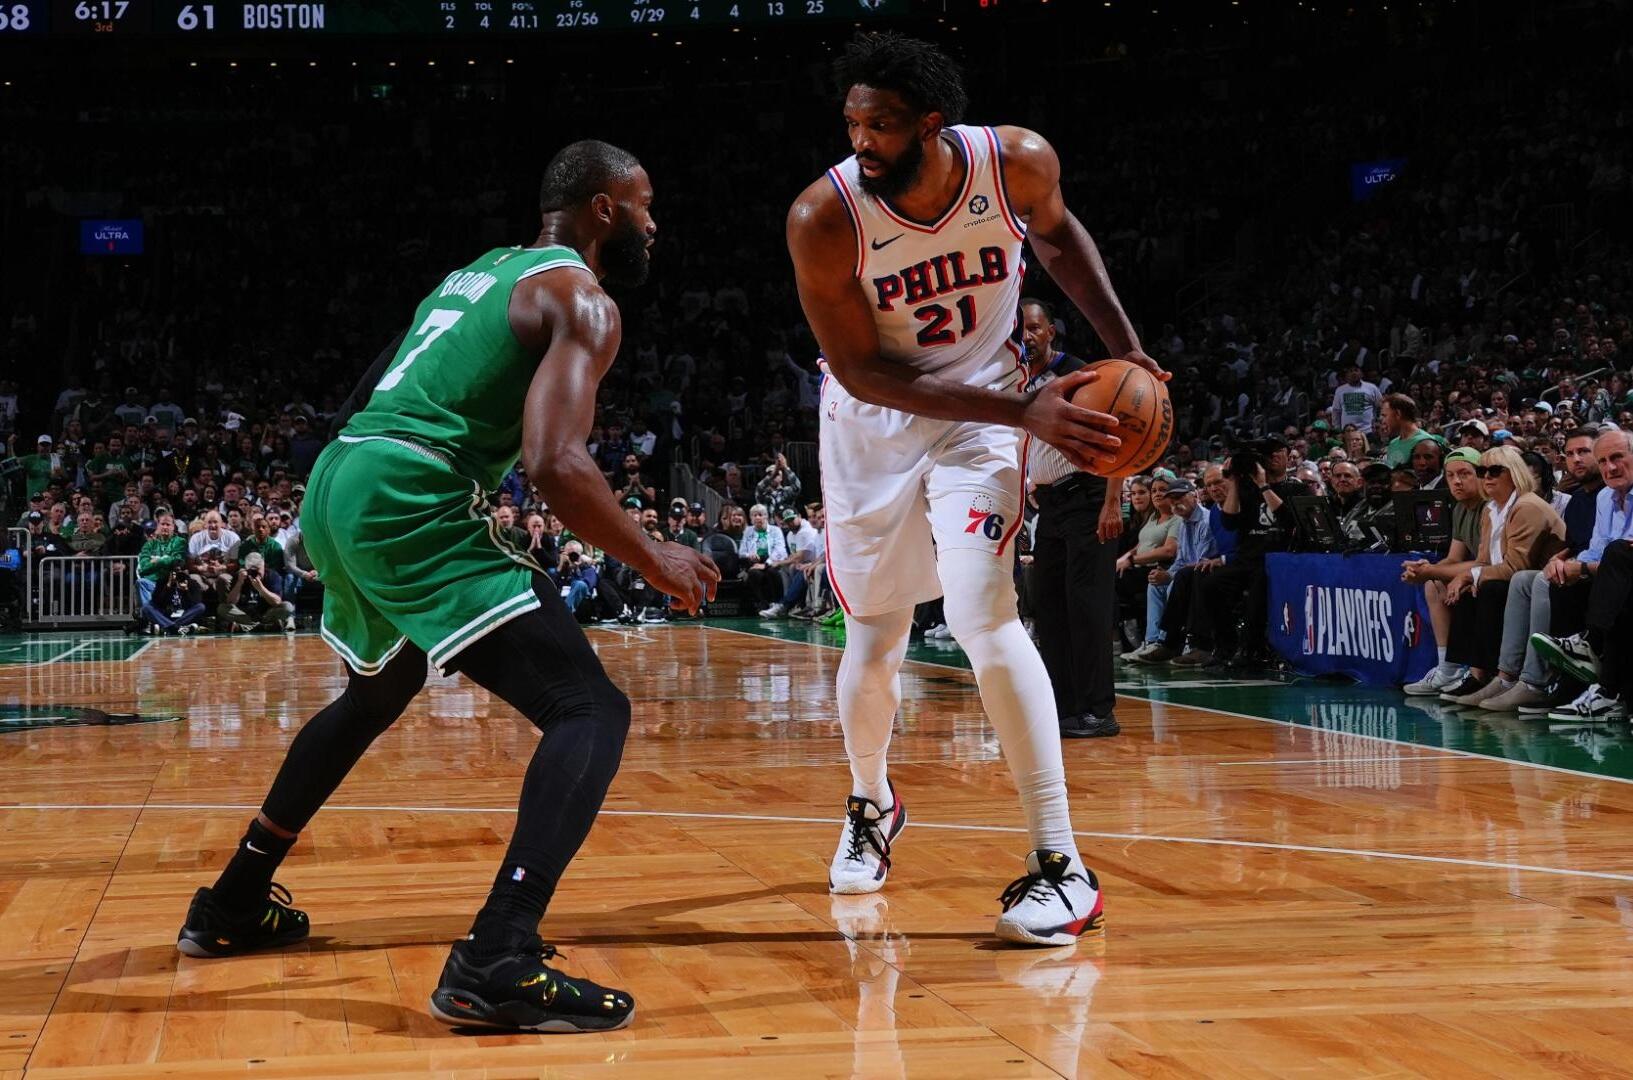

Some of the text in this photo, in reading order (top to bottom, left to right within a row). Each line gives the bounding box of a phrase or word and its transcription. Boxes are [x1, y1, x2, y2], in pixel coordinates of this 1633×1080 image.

[74, 1, 130, 20] 6:17
[176, 5, 215, 30] 61
[243, 4, 325, 30] BOSTON
[440, 3, 457, 11] FLS
[474, 3, 493, 11] TOL
[511, 2, 534, 11] FG%
[569, 0, 583, 9] FG
[445, 1, 825, 29] 2 4 41.1 23/56 9/29 4 4 13 25
[94, 22, 113, 33] 3rd
[963, 213, 1001, 229] crypto.com
[94, 231, 130, 240] ULTRA
[873, 246, 1009, 312] PHILA
[913, 294, 977, 348] 21
[374, 308, 464, 391] 7
[964, 507, 1005, 541] 76
[1317, 586, 1395, 663] PLAYOFFS
